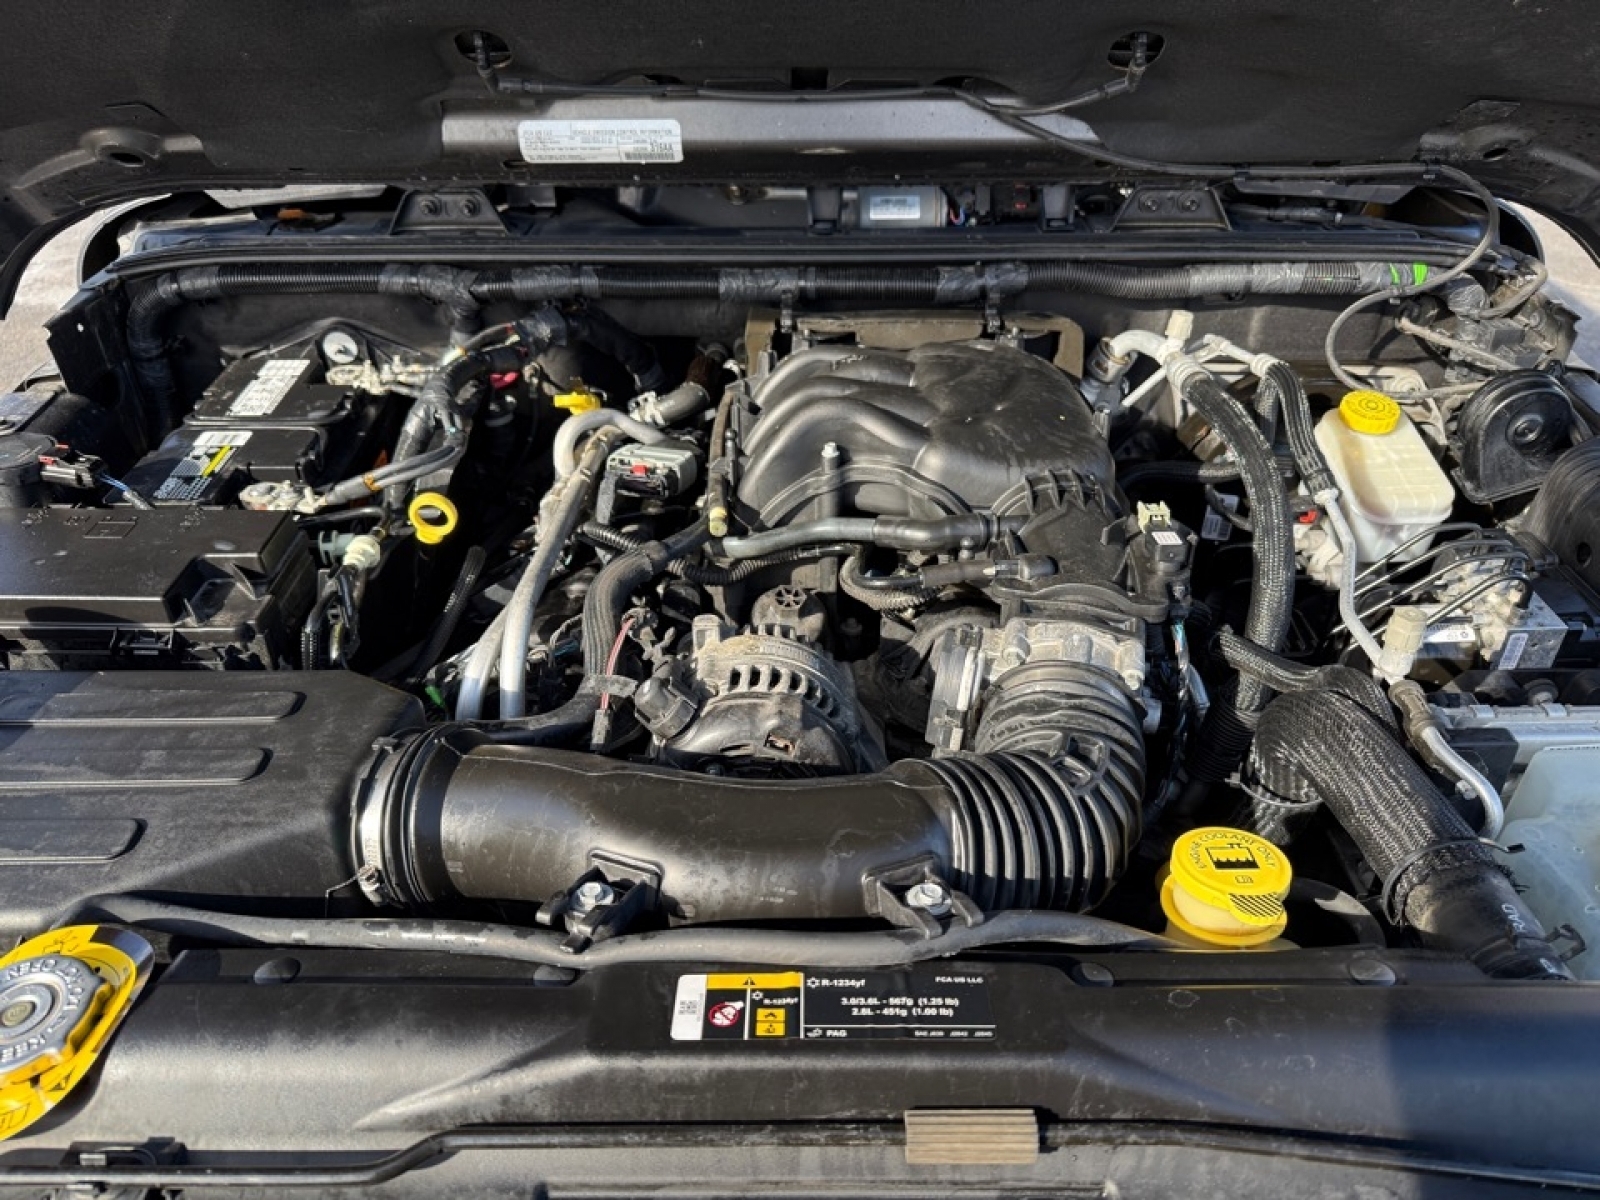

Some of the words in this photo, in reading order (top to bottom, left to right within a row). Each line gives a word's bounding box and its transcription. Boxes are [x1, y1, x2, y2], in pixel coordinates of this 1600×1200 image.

[821, 979, 865, 989] R-1234yf
[939, 1007, 954, 1018] lb)
[826, 1029, 847, 1037] PAG
